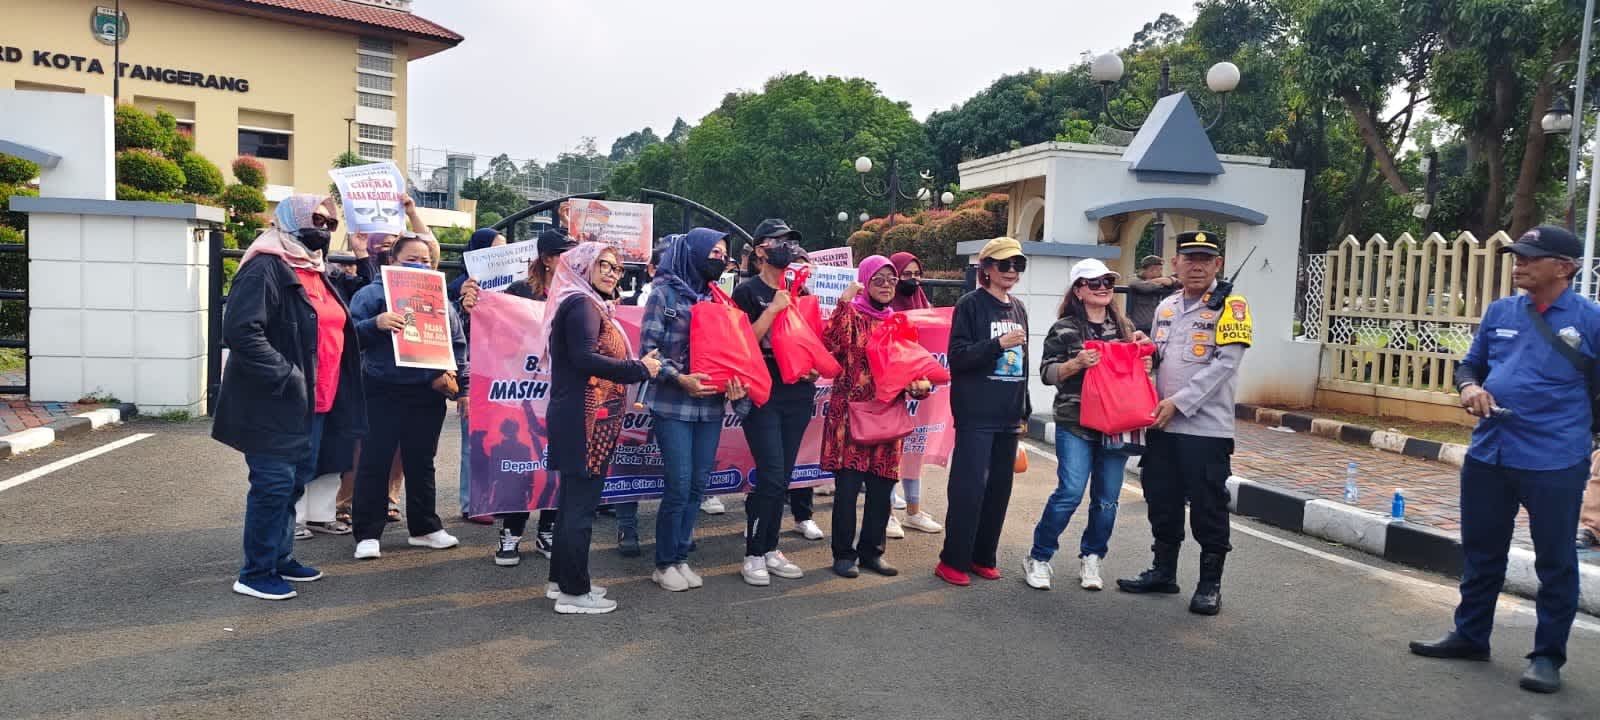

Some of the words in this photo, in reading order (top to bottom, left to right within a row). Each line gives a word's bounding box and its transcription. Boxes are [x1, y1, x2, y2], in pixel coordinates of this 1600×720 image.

[33, 50, 104, 75] KOTA
[115, 62, 249, 93] TANGERANG
[489, 380, 549, 400] MASIH
[502, 461, 540, 473] Depan
[616, 455, 642, 465] Kota
[603, 480, 632, 491] Media
[632, 479, 656, 489] Citra
